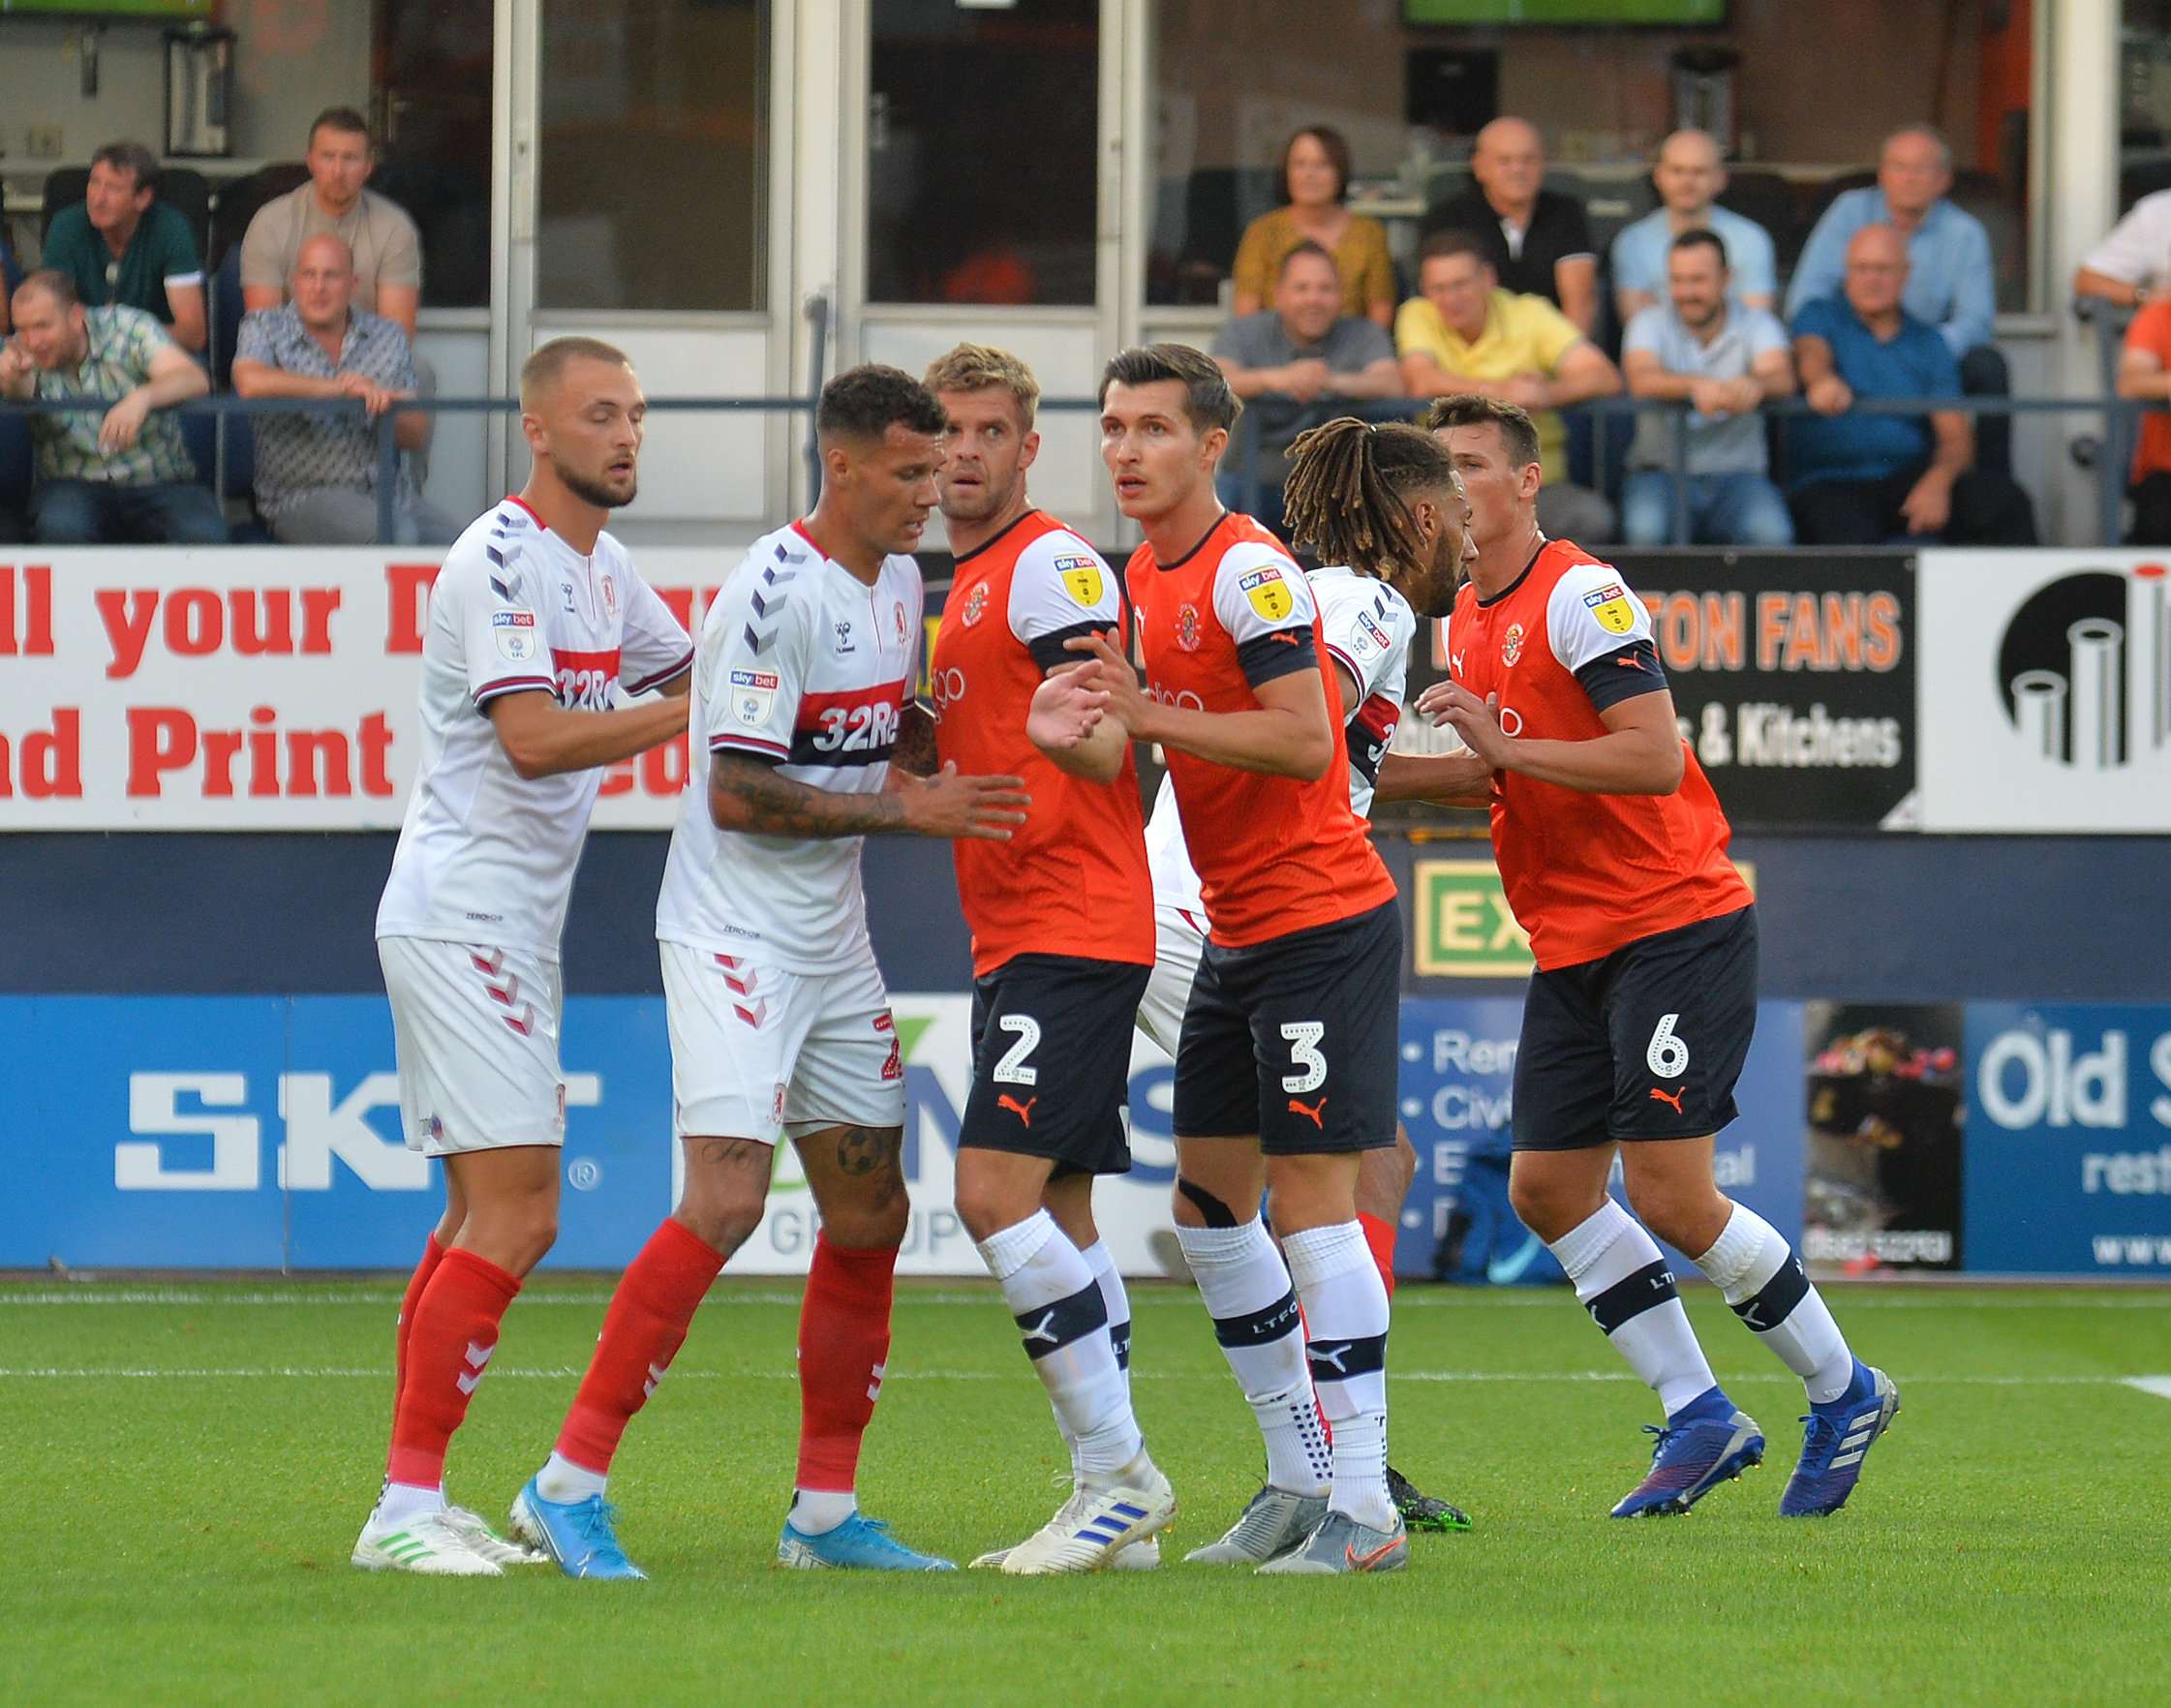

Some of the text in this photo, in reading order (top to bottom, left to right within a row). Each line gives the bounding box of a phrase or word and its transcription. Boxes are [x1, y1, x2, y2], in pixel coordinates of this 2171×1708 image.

[1056, 559, 1075, 569] sky
[1241, 569, 1280, 589] sky bet
[1585, 587, 1623, 606] sky bet
[94, 587, 341, 681] your
[494, 613, 533, 626] sky bet
[1360, 613, 1389, 647] sky bet
[1756, 591, 1902, 672] FANS
[733, 671, 776, 687] sky bet
[0, 707, 83, 800] d
[125, 706, 394, 800] Print
[1697, 701, 1733, 768] &
[1737, 702, 1902, 768] Kitchens
[994, 1013, 1042, 1086] 2
[1279, 1021, 1328, 1094] 3
[1646, 1013, 1689, 1079] 6
[1977, 1029, 2128, 1130] Old
[114, 1072, 599, 1191] SK
